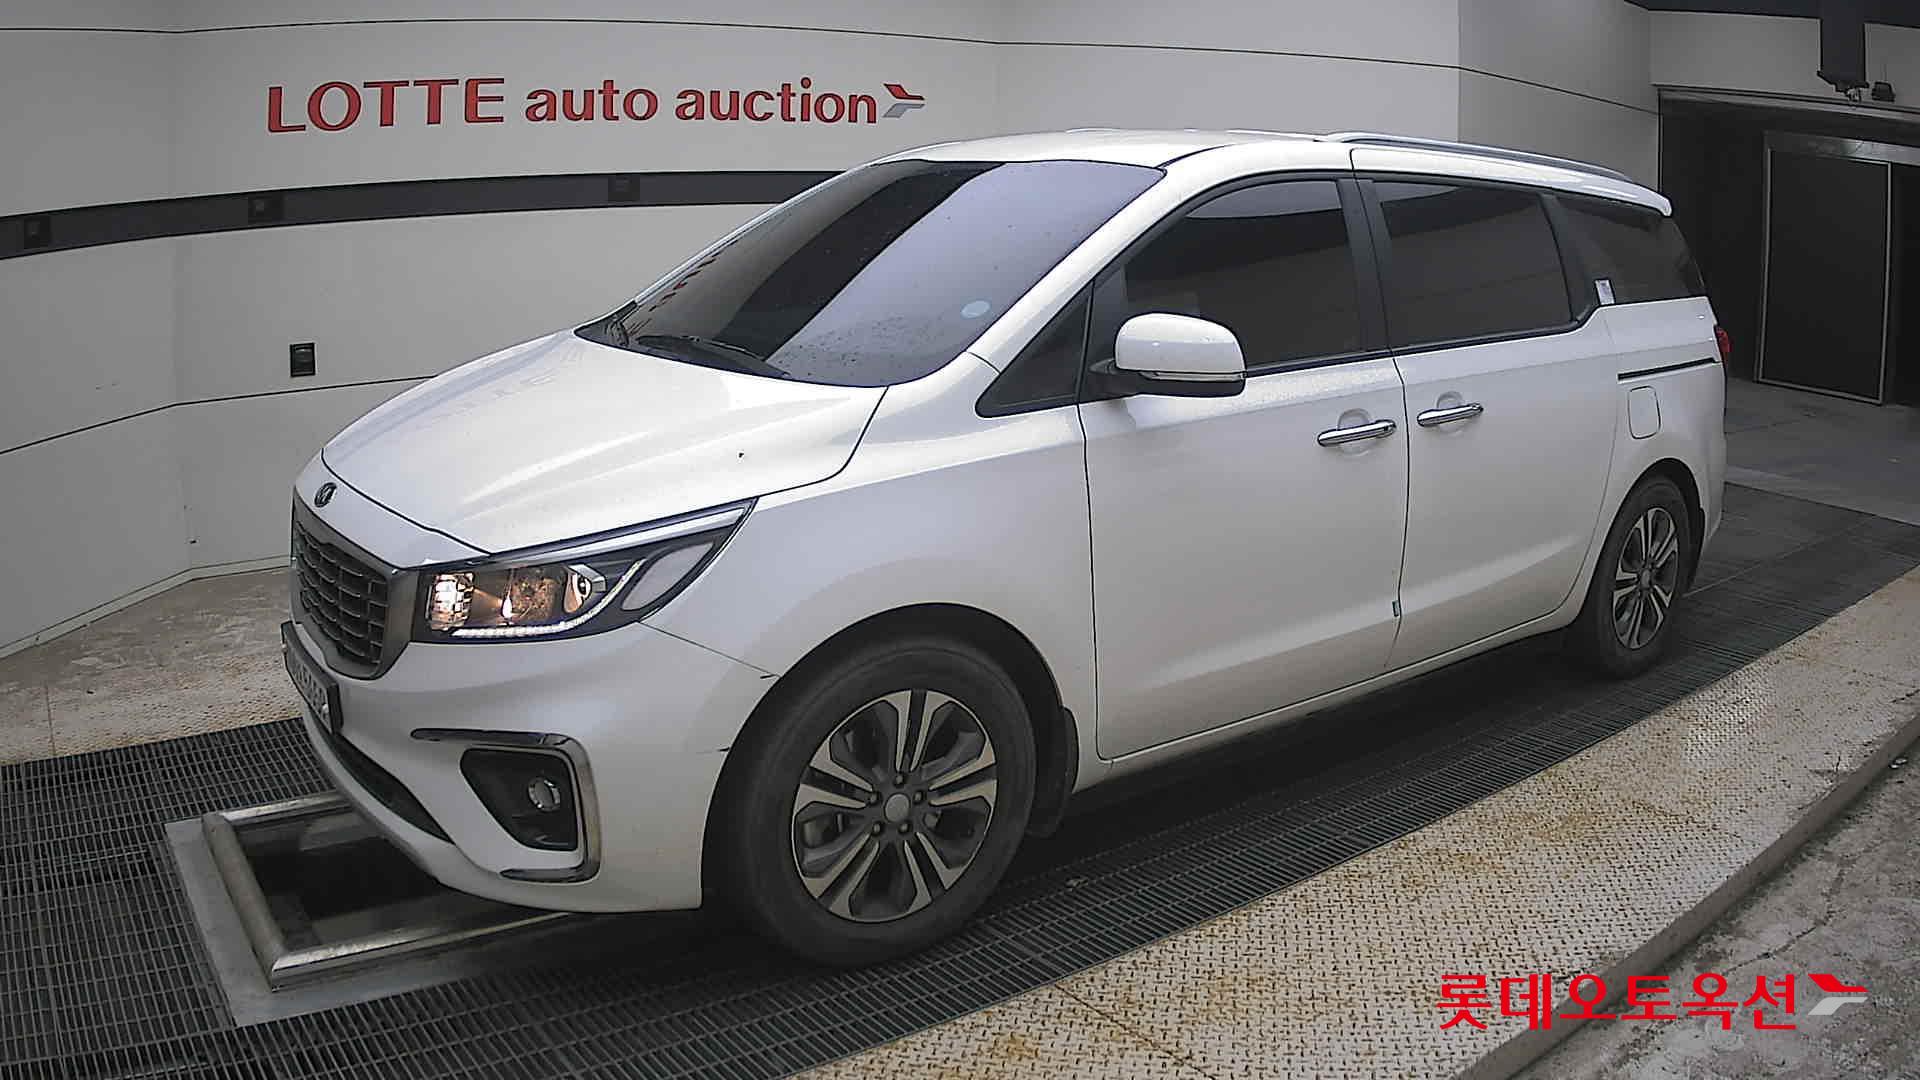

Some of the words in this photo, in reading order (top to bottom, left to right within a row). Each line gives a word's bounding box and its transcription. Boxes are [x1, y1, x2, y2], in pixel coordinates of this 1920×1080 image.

[268, 78, 505, 133] LOTTE
[525, 79, 659, 122] auto
[674, 77, 878, 125] auction
